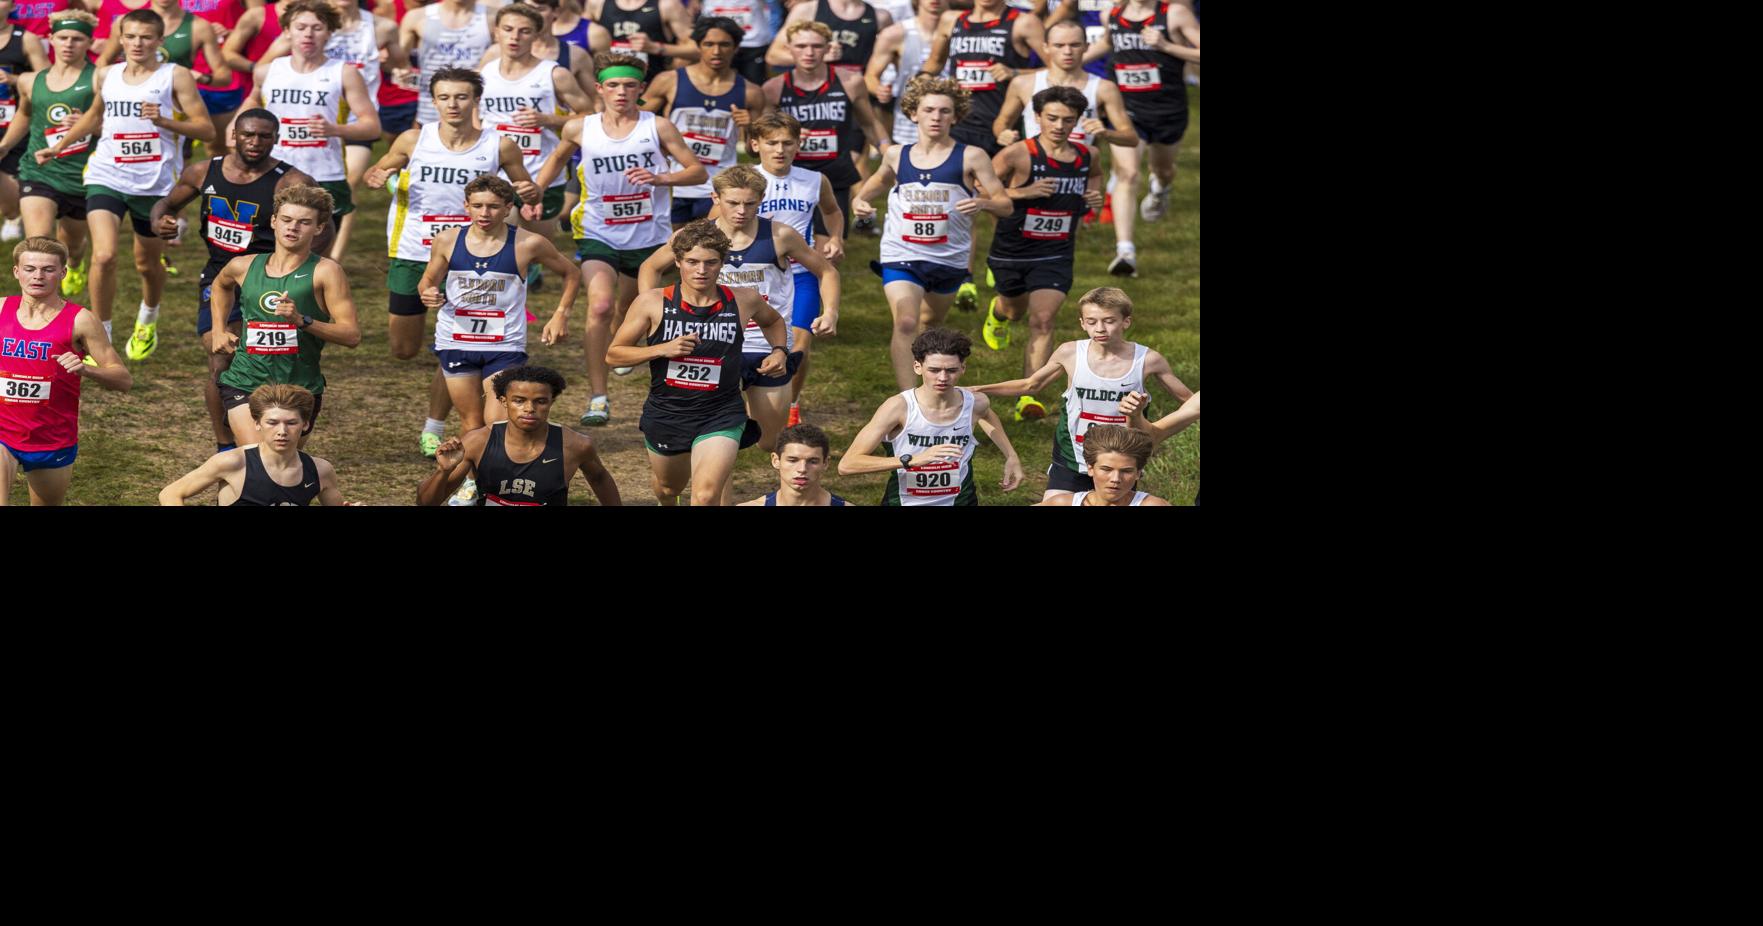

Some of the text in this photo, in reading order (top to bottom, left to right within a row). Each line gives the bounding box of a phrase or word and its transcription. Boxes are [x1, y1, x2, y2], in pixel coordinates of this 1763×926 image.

[271, 89, 329, 106] PIUS X
[485, 97, 543, 112] PIUS X
[106, 101, 142, 117] PIUS
[121, 141, 152, 155] 564
[692, 142, 711, 156] 95
[592, 152, 656, 174] PIUS X
[420, 166, 469, 185] PIUS
[612, 202, 642, 217] 557
[757, 199, 813, 213] EARNEY
[914, 223, 935, 236] 88
[1033, 218, 1063, 231] 249
[214, 226, 243, 244] 945
[470, 319, 487, 333] 77
[663, 319, 737, 344] HASTINGS
[256, 331, 287, 346] 219
[2, 337, 52, 360] EAST
[676, 365, 711, 381] 252
[6, 381, 41, 398] 362
[499, 478, 536, 497] LSE
[916, 473, 951, 488] 920
